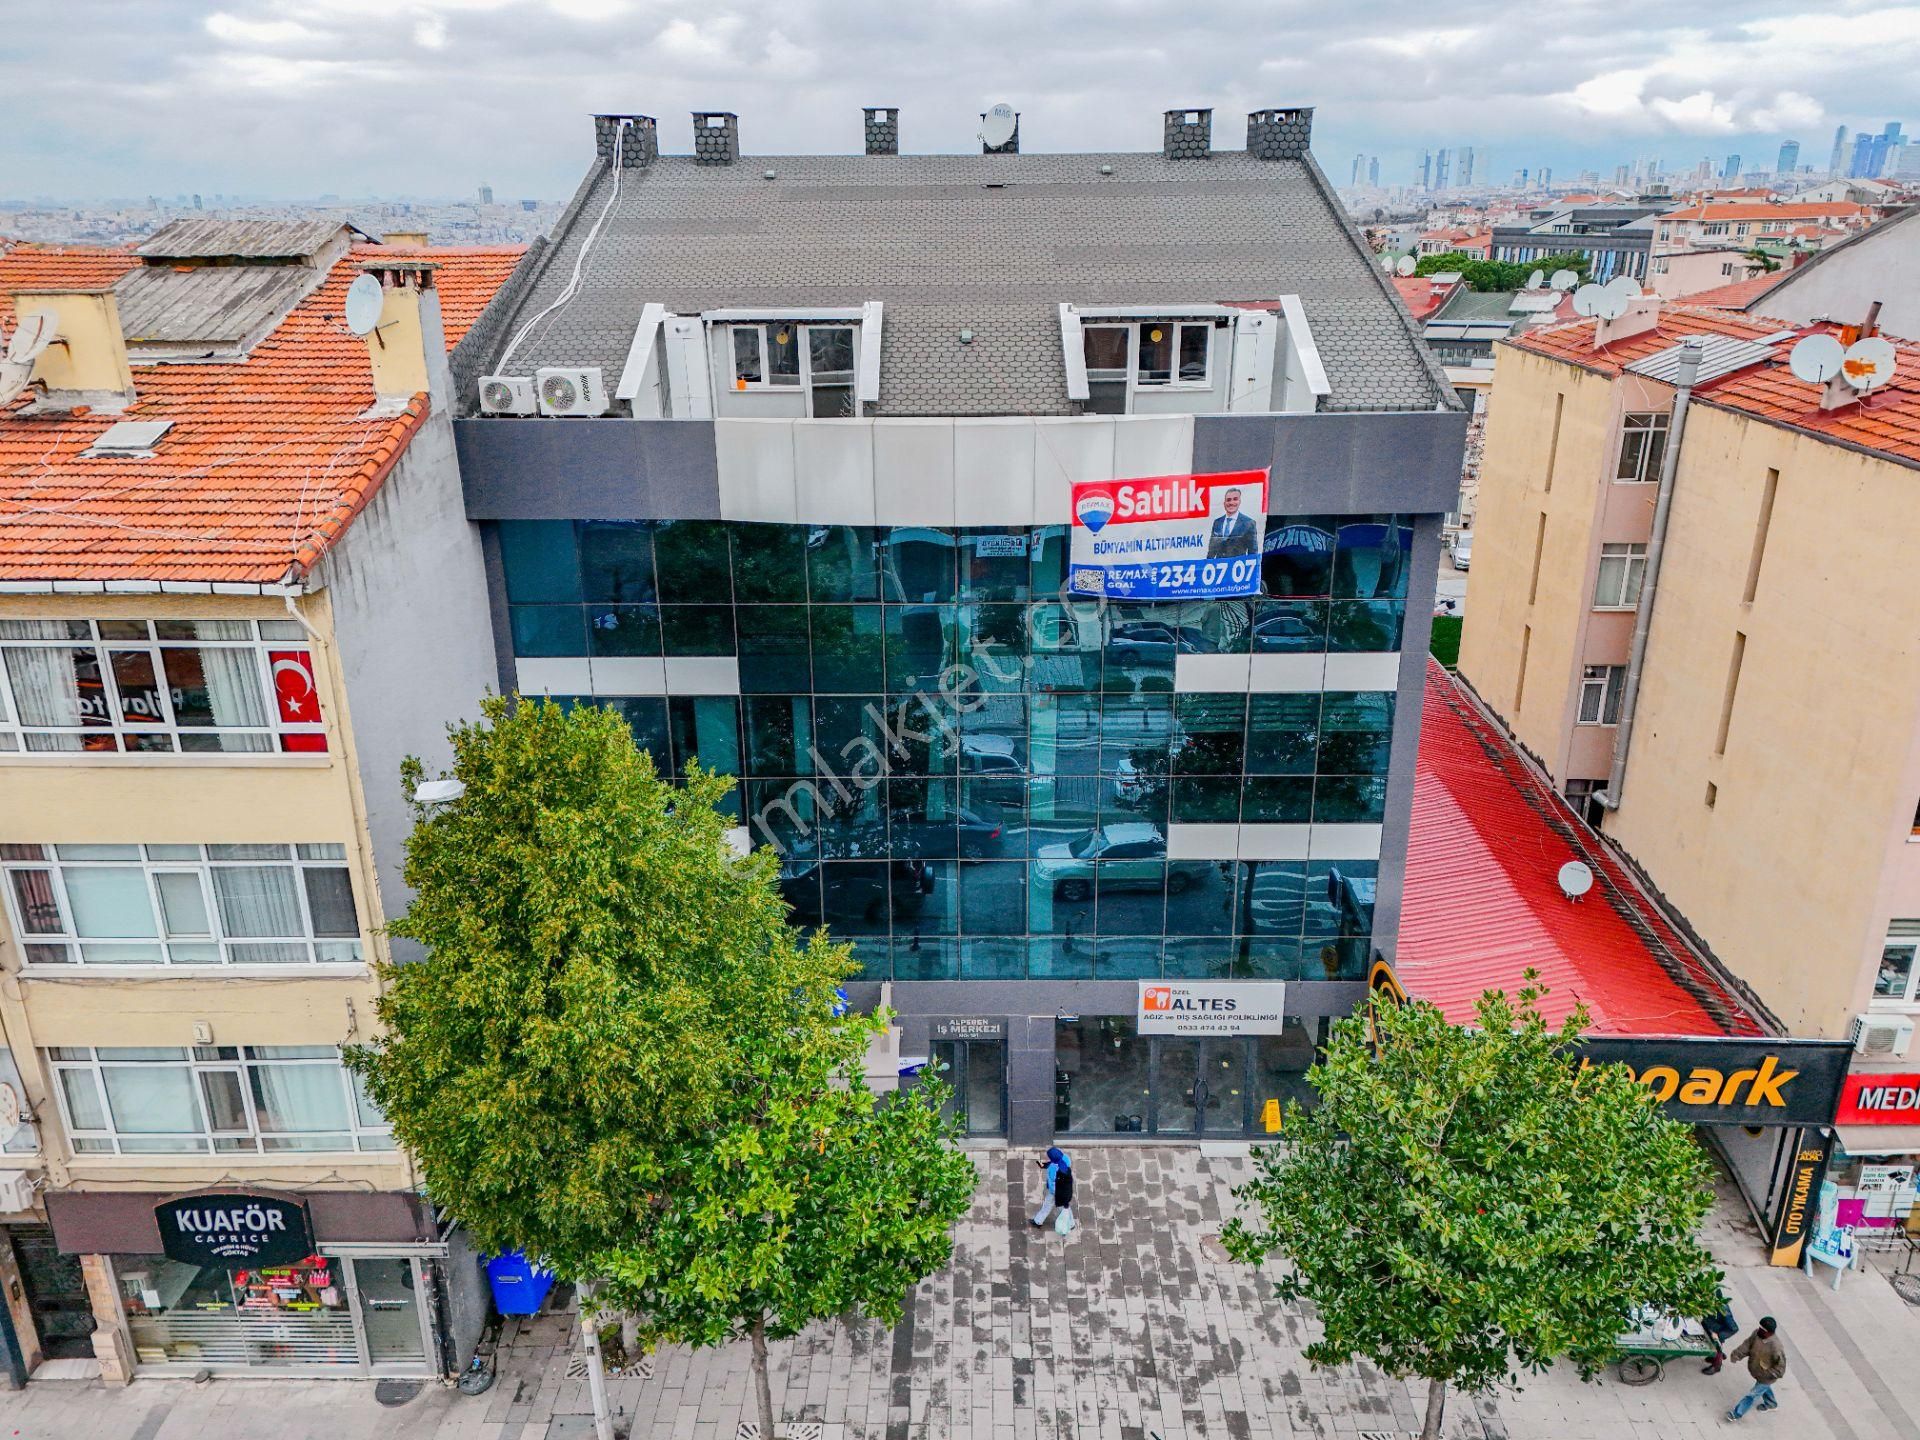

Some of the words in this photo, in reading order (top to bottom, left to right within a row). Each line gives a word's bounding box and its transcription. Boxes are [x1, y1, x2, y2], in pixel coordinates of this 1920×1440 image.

[1117, 480, 1205, 517] Satılık
[1145, 534, 1204, 551] ALTIPARMAK
[1108, 568, 1148, 580] RE/MAX
[1158, 564, 1196, 588] 234
[1202, 562, 1229, 585] 07
[1232, 559, 1257, 583] 07
[1107, 581, 1136, 589] GOAL
[1171, 998, 1236, 1011] ALTES
[1176, 1013, 1190, 1021] DİŞ
[950, 1024, 1000, 1033] MERKEZİ
[1791, 1167, 1814, 1211] YIKAMA
[175, 1204, 286, 1232] KUAFÖR
[1786, 1212, 1803, 1234] OTO
[195, 1234, 269, 1243] CAPRICE
